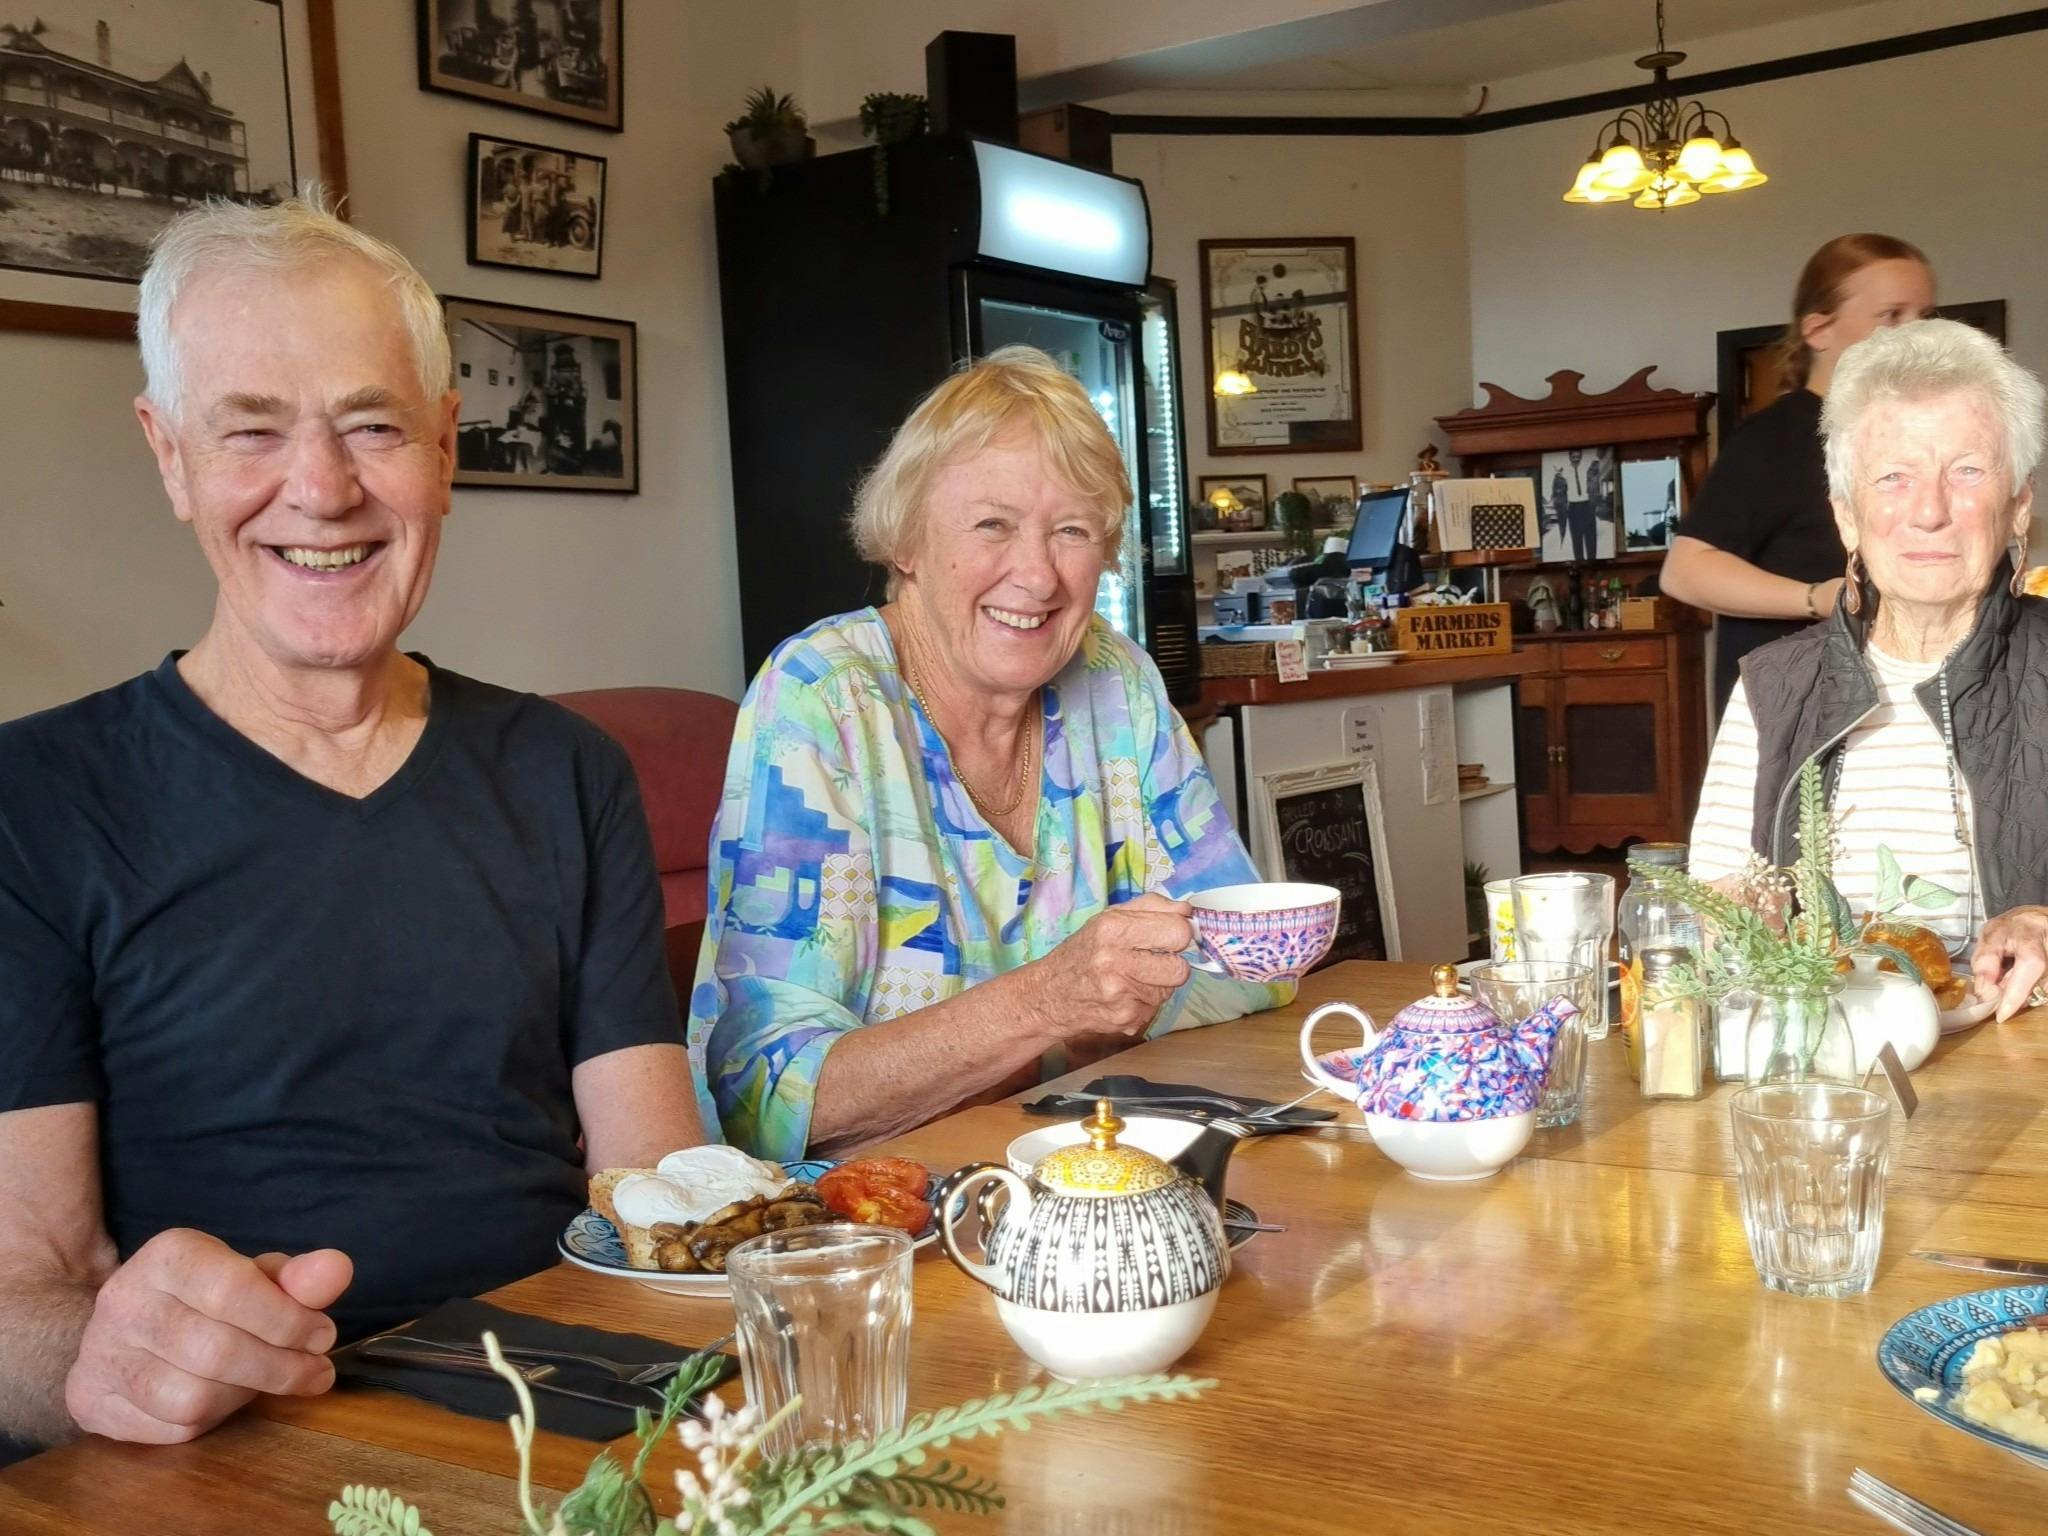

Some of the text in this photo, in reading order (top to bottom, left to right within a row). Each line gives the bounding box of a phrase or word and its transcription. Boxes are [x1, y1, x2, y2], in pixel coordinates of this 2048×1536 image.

[1410, 613, 1501, 633] FARMERS
[1416, 631, 1497, 651] MARKET
[1295, 816, 1363, 858] CROISSANT
